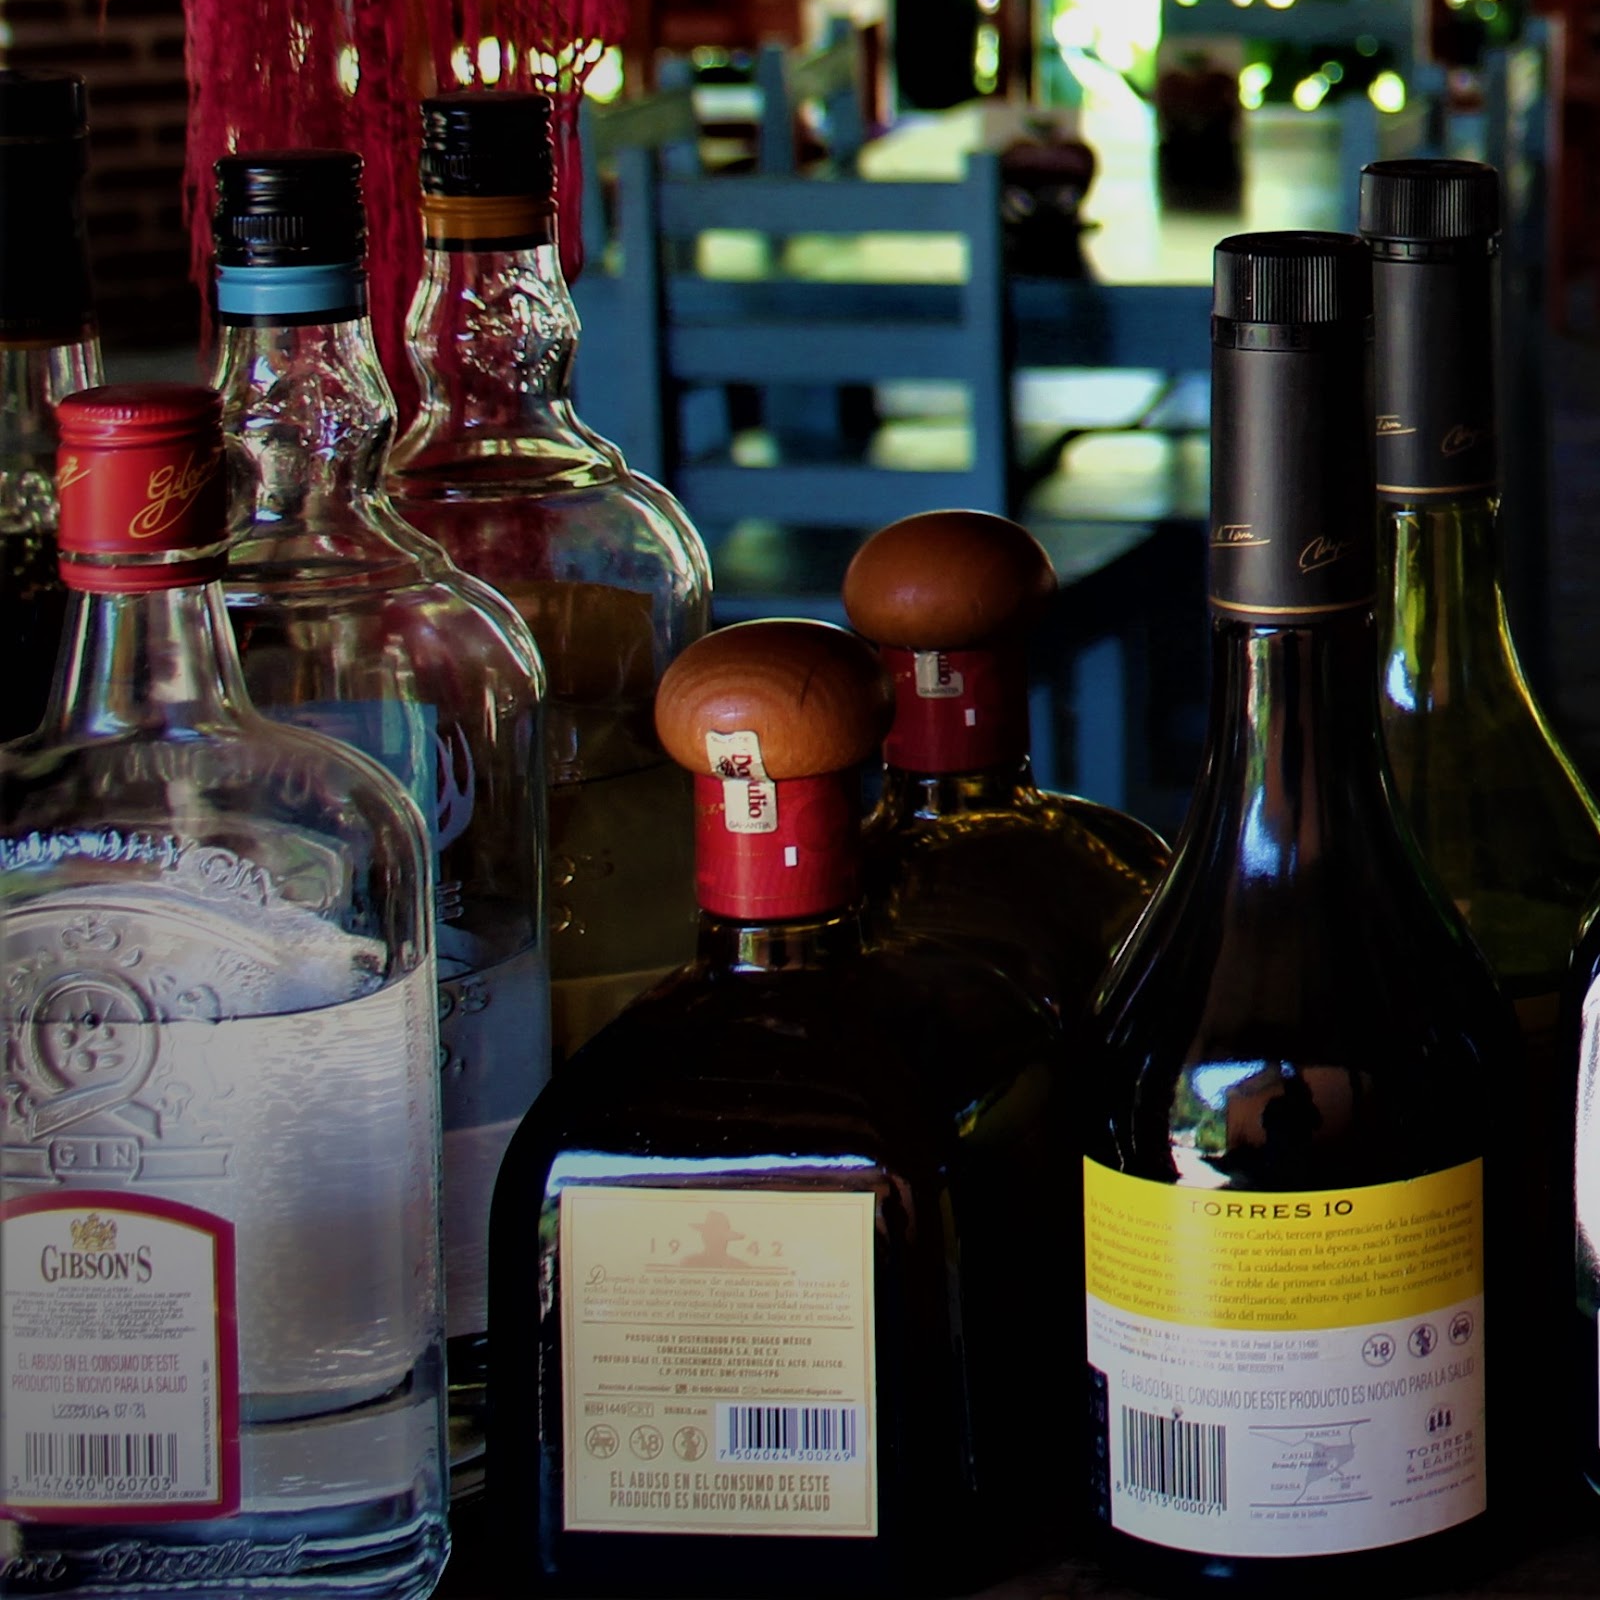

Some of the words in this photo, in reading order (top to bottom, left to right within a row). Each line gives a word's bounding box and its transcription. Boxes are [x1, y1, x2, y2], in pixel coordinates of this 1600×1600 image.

[1190, 1198, 1313, 1220] TORRES
[1323, 1198, 1355, 1217] 10
[40, 1244, 153, 1284] GIBSON'S
[17, 1353, 30, 1371] EL
[31, 1353, 63, 1372] ABUSO
[63, 1354, 77, 1372] EN
[78, 1354, 90, 1372] EL
[90, 1353, 140, 1373] CONSUMO
[140, 1353, 155, 1372] DE
[156, 1353, 180, 1372] ESTE
[11, 1374, 61, 1393] PRODUCTO
[62, 1374, 75, 1393] ES
[75, 1375, 113, 1393] NOCIVO
[113, 1375, 139, 1394] PARA
[140, 1376, 155, 1393] LA
[155, 1375, 189, 1393] SALUD
[1188, 1385, 1243, 1410] CONSUMO
[1243, 1390, 1260, 1410] DE
[1260, 1389, 1289, 1411] ESTE
[1288, 1387, 1351, 1410] PRODUCTO
[1351, 1384, 1367, 1404] ES
[1366, 1379, 1407, 1402] NOCIVO
[734, 1449, 789, 1462] 506064
[796, 1449, 852, 1463] 300269
[33, 1476, 97, 1492] 147690
[104, 1476, 172, 1492] 060703
[609, 1470, 625, 1490] EL
[628, 1472, 670, 1491] ABUSO
[674, 1472, 691, 1491] EN
[694, 1473, 710, 1492] EL
[713, 1474, 775, 1492] CONSUMO
[778, 1474, 795, 1492] DE
[799, 1475, 831, 1493] ESTE
[608, 1490, 672, 1509] PRODUCTO
[674, 1492, 690, 1510] ES
[692, 1492, 737, 1511] NOCIVO
[739, 1492, 772, 1512] PARA
[774, 1493, 791, 1512] LA
[792, 1493, 831, 1513] SALUD
[1173, 1498, 1223, 1517] 000071
